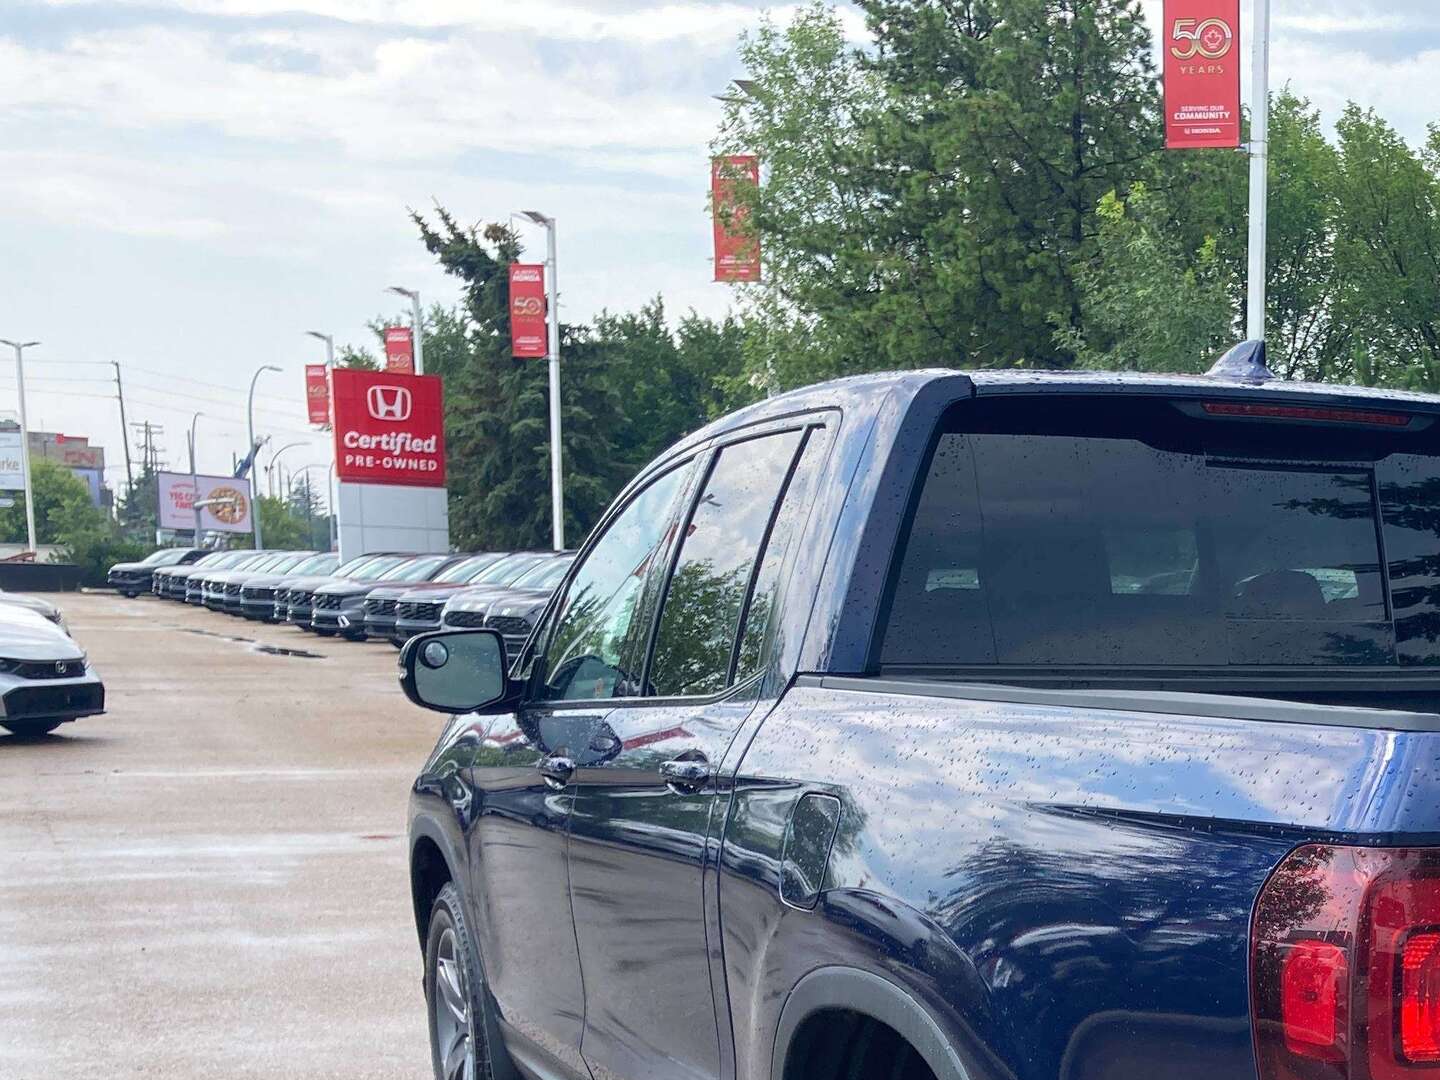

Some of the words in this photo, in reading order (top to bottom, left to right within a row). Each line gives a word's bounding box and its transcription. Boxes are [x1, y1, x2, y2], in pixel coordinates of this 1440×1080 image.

[1171, 17, 1233, 59] 50
[1179, 65, 1224, 75] YEARS
[1173, 111, 1231, 120] COMMUNITY
[343, 430, 437, 456] Certified
[345, 454, 438, 471] PRE-OWNED
